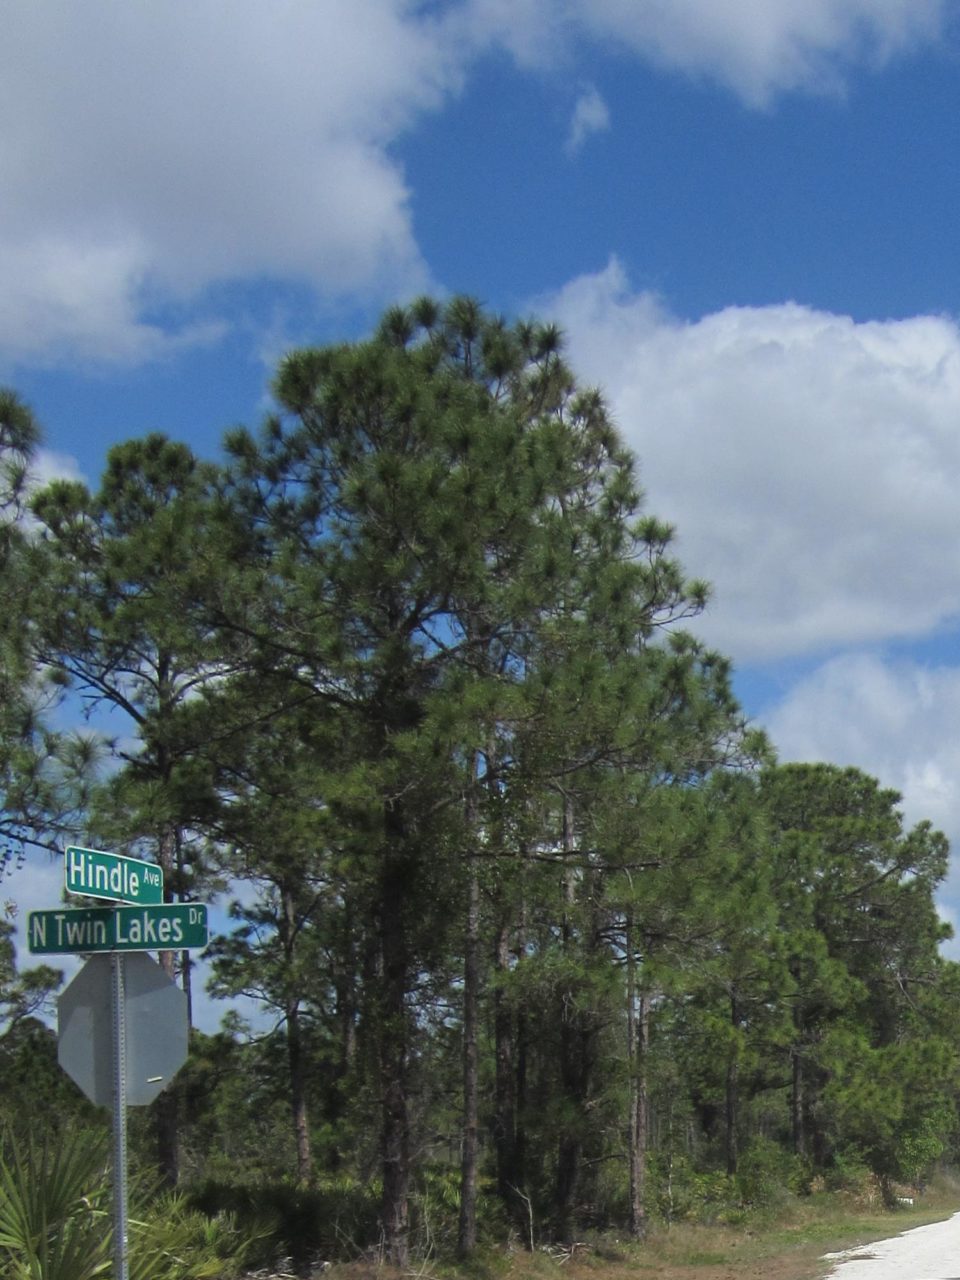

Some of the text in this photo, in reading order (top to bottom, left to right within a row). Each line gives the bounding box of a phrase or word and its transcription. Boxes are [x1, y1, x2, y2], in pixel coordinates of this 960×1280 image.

[70, 851, 160, 897] Hindle Ave
[33, 907, 203, 947] N Twin Lakes Dr
